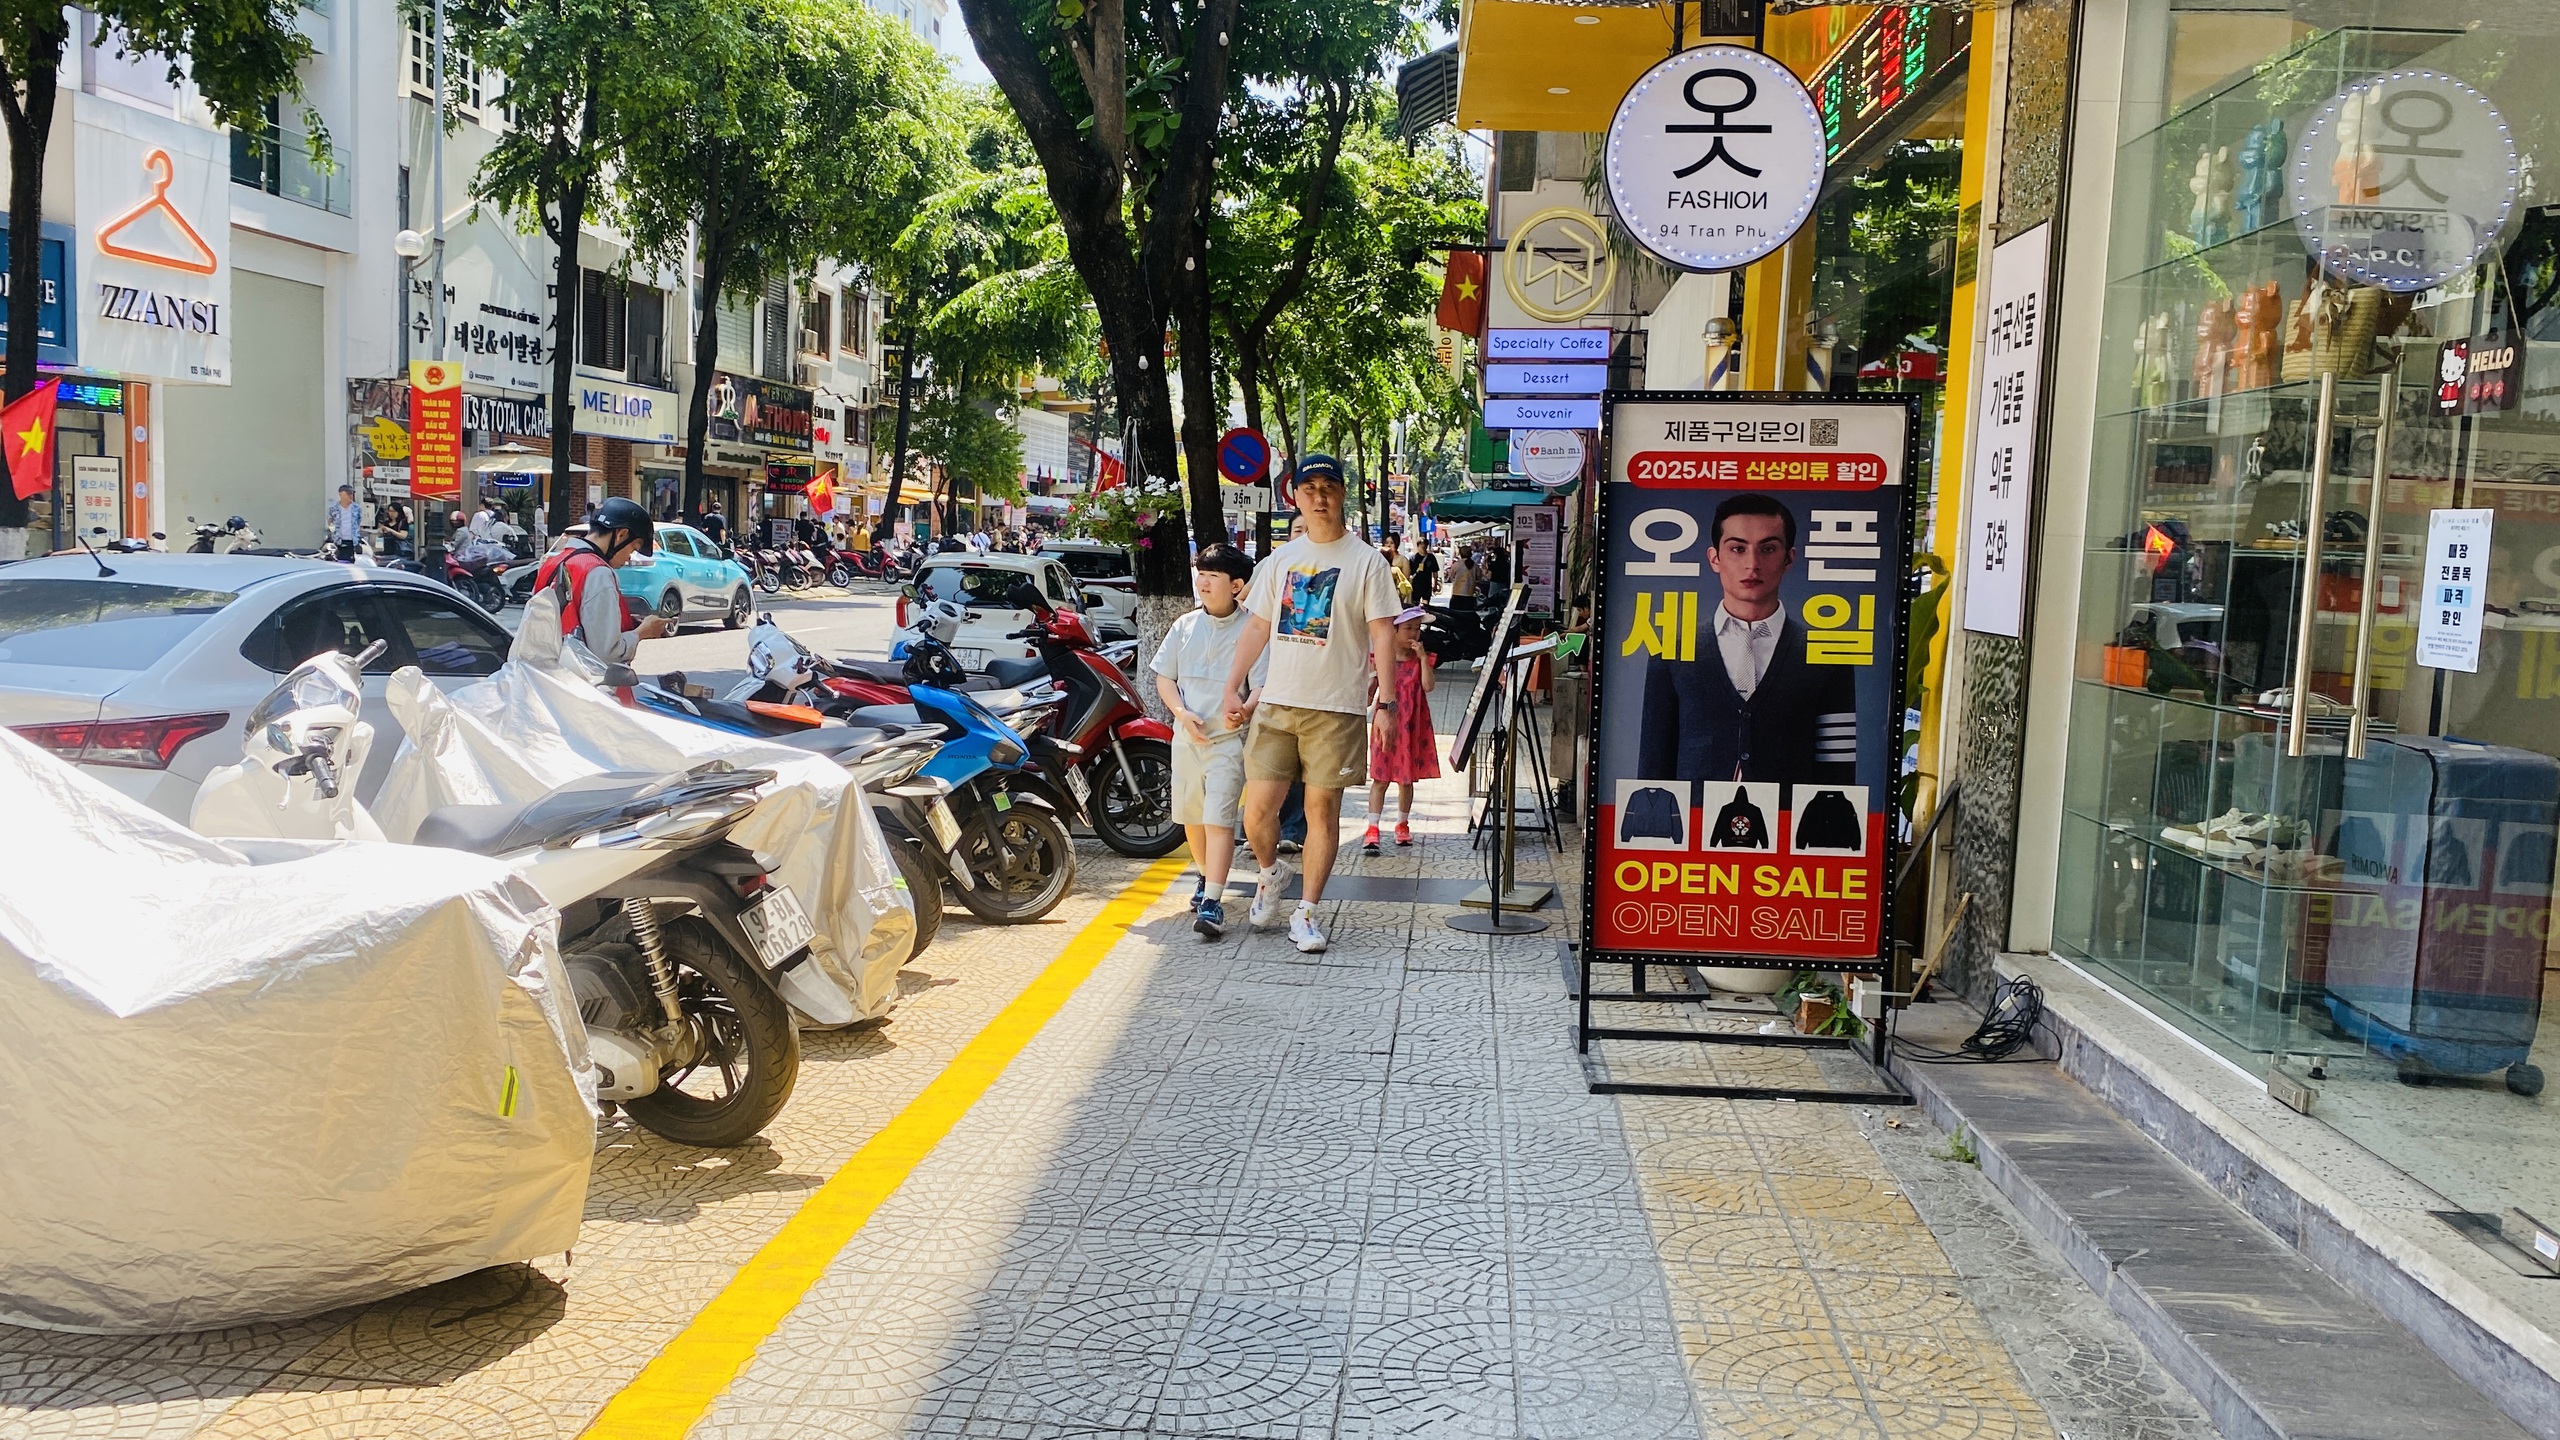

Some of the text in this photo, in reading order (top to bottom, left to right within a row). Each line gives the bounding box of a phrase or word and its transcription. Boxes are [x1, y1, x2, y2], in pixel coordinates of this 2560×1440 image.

[1659, 225, 1767, 238] 94 Tran Phu
[101, 283, 219, 336] ZZANSI
[1991, 292, 2036, 357] 귀국선물
[412, 312, 543, 365] 수 네일&이발관
[1493, 337, 1603, 351] Specialty Coffee
[2469, 346, 2514, 374] HELLO
[1523, 372, 1569, 384] Dessert
[888, 383, 919, 397] Hoel
[1991, 370, 2024, 428] 기념품
[583, 389, 653, 419] MELIOR
[1516, 406, 1573, 419] Souvenir
[463, 396, 549, 438] ILS & TOTAL CARE
[596, 416, 637, 428] LUXURY
[1664, 421, 1805, 443] 제품구입문의
[1525, 447, 1530, 456] I
[1540, 446, 1565, 456] Banh
[1638, 460, 1878, 482] 2025시즌 신상의류 할인
[1989, 446, 2012, 500] 의류
[80, 479, 116, 491] 찾으시는
[1233, 492, 1251, 505] 35m
[1985, 519, 2008, 572] 잡화
[2448, 543, 2469, 559] 매장
[2441, 566, 2471, 581] 전품목
[2443, 588, 2464, 604] 파격
[2442, 610, 2461, 626] 할인
[957, 649, 972, 659] 43A
[1614, 860, 1868, 900] OPEN SALE
[750, 901, 795, 936] 92-BA
[1612, 901, 1867, 943] OPEN SALE
